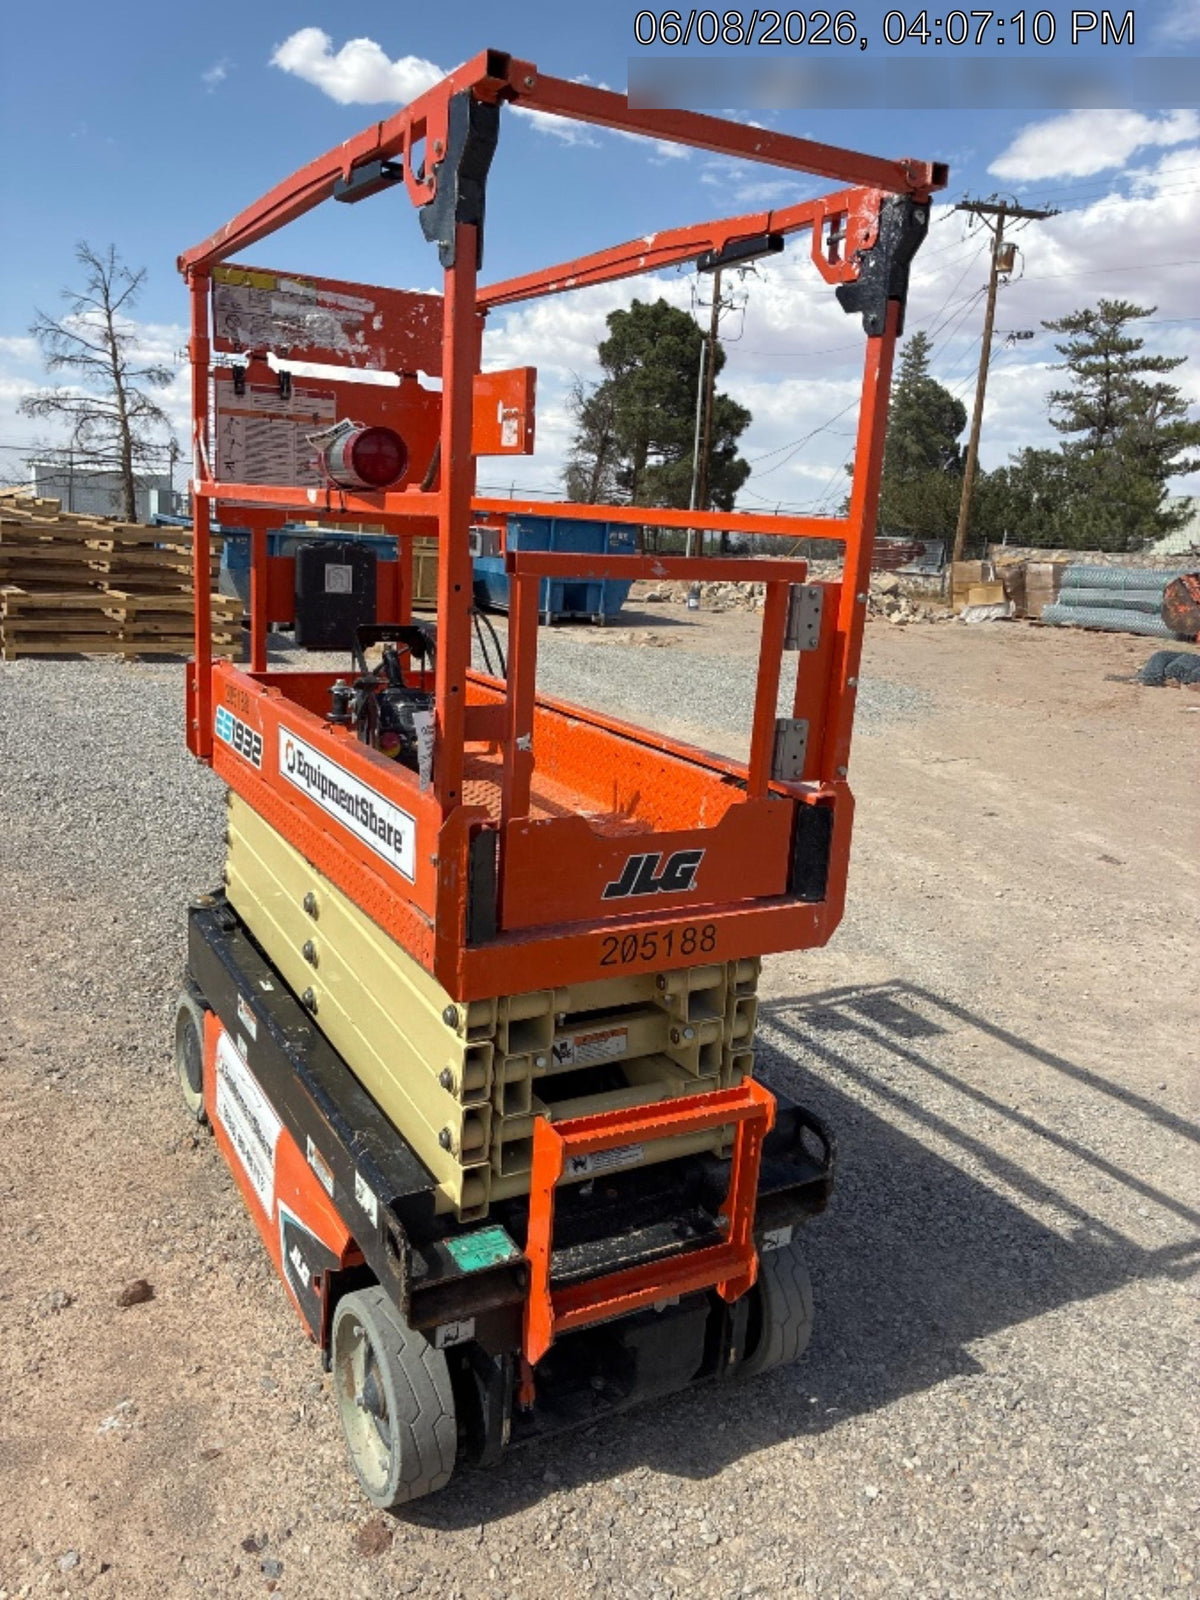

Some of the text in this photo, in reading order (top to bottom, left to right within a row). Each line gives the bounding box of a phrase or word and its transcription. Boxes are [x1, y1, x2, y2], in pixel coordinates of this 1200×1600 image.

[296, 750, 403, 854] EquipmentShare
[601, 848, 706, 900] JLG
[600, 924, 716, 966] 205188
